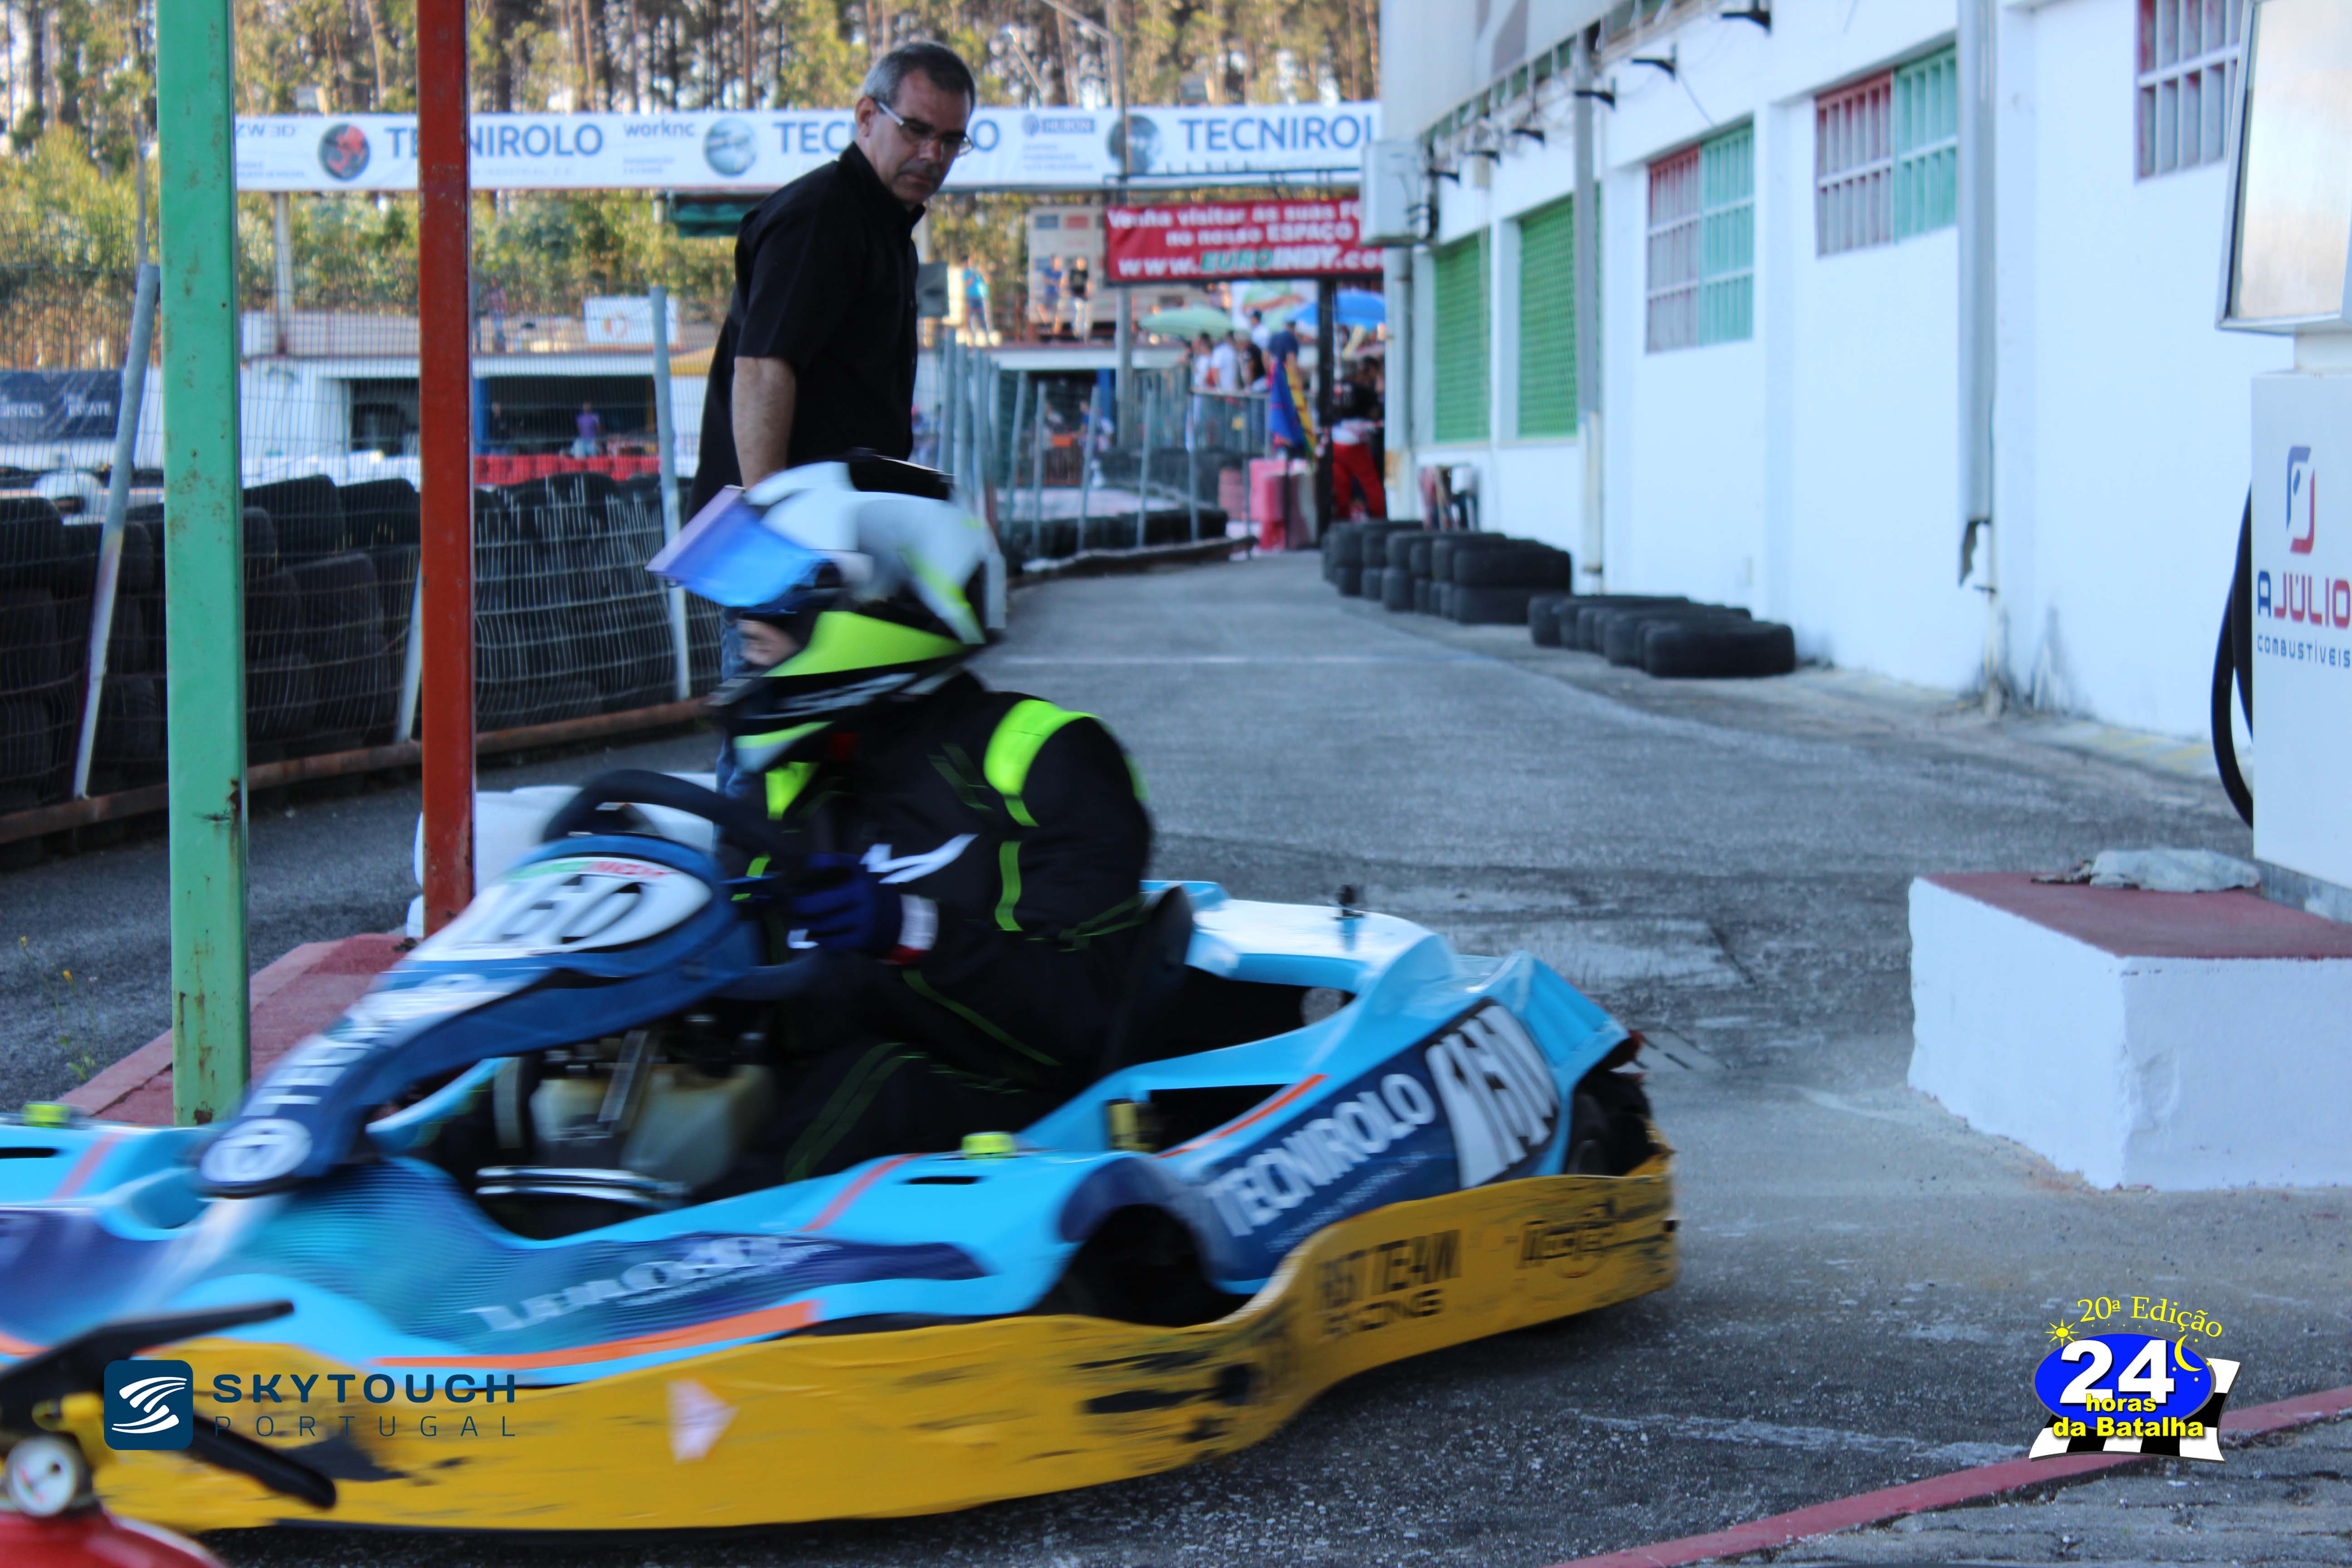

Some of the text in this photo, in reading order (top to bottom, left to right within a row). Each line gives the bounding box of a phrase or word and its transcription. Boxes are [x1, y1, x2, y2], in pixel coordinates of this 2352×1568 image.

[384, 122, 603, 159] TNIROLO
[623, 118, 696, 137] worknc
[1178, 114, 1372, 152] TECNIRO
[1177, 206, 1246, 226] visitar
